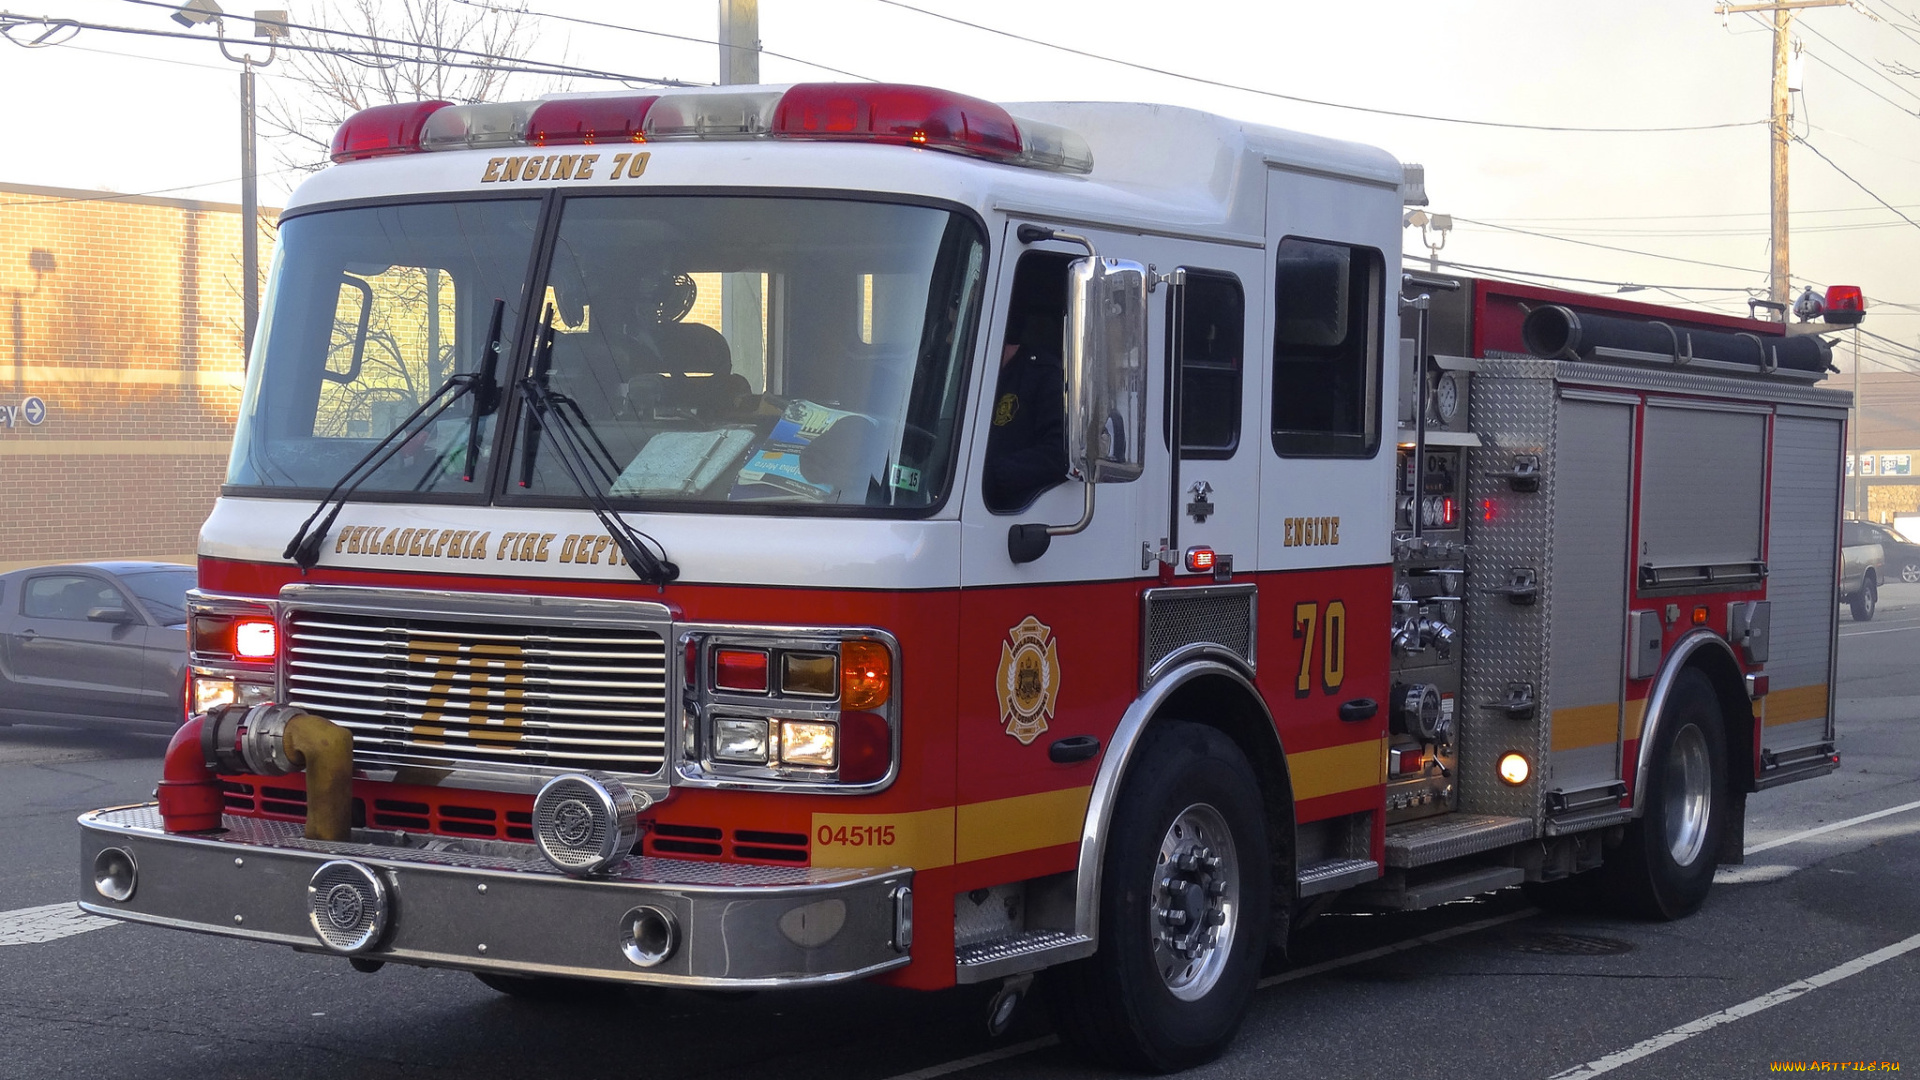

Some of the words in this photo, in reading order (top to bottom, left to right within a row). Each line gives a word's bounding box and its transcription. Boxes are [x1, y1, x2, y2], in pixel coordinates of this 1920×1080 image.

[481, 154, 600, 183] ENGINE
[610, 152, 651, 180] 70
[335, 525, 491, 559] PHILADELPHIA
[496, 532, 557, 563] FIRE
[1284, 517, 1340, 547] ENGINE
[1293, 599, 1346, 699] 70
[408, 640, 526, 751] 70
[817, 825, 895, 846] 045115
